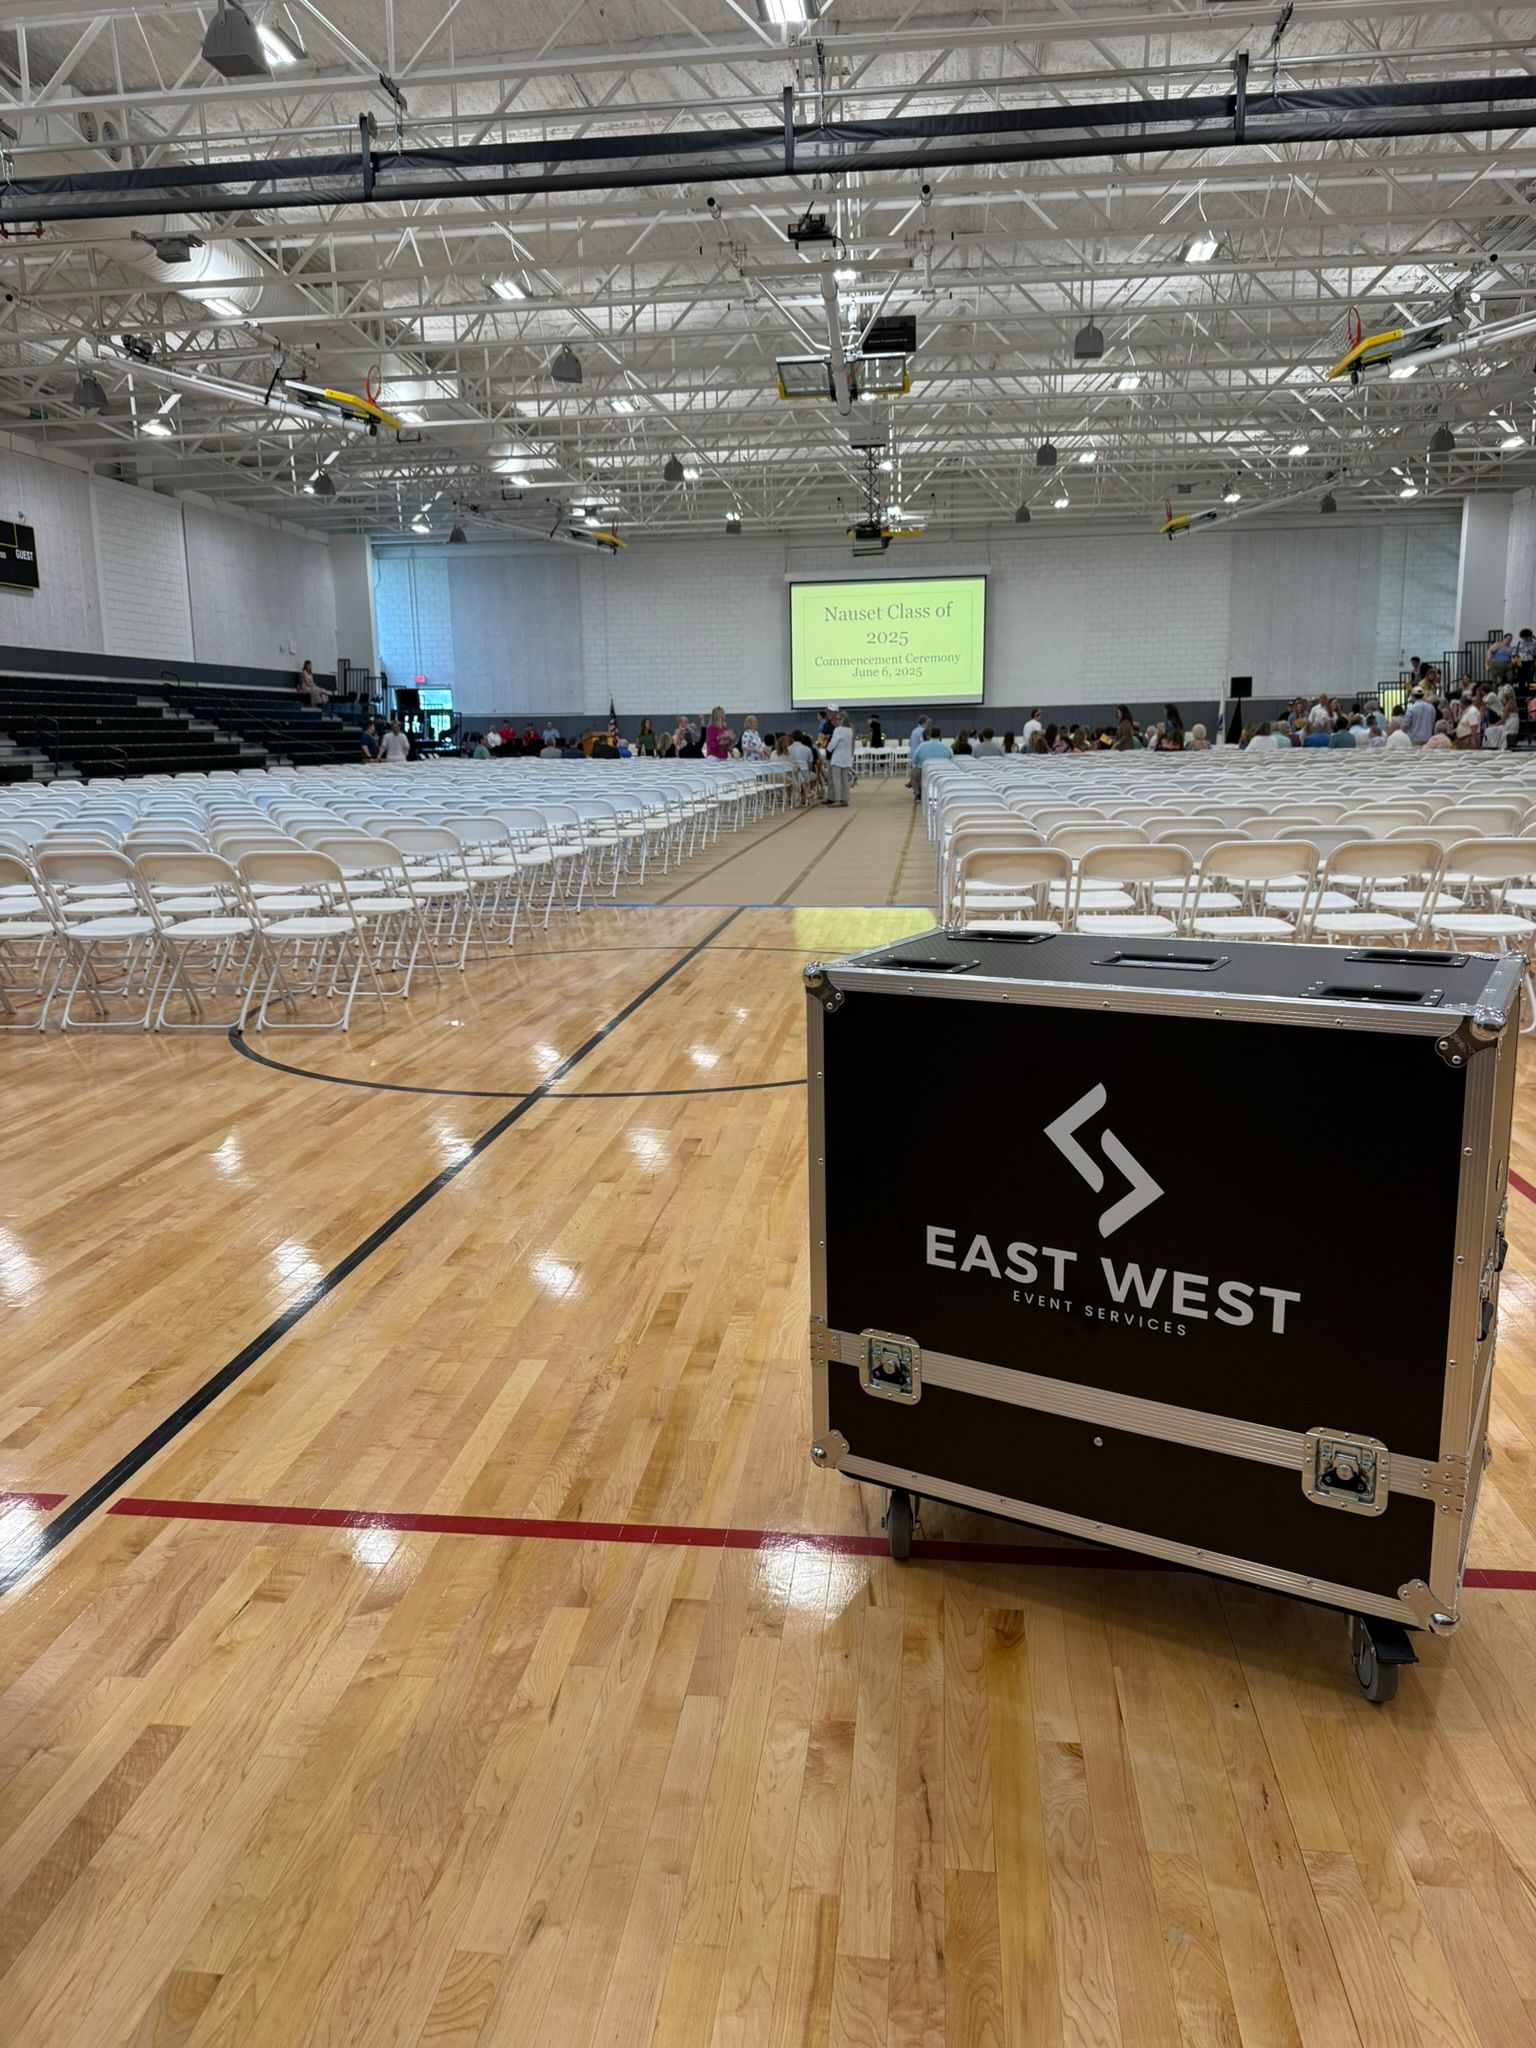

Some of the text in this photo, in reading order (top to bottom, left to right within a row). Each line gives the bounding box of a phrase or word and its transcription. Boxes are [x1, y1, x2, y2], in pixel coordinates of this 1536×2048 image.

[15, 549, 34, 561] GUEST
[824, 601, 954, 622] Nauset Class of
[866, 631, 909, 646] 2025
[815, 653, 961, 667] Commencement Ceremony
[852, 667, 922, 678] June 6, 2025
[926, 1225, 1301, 1335] EAST WEST
[1013, 1290, 1187, 1336] EVENT SERVICES
